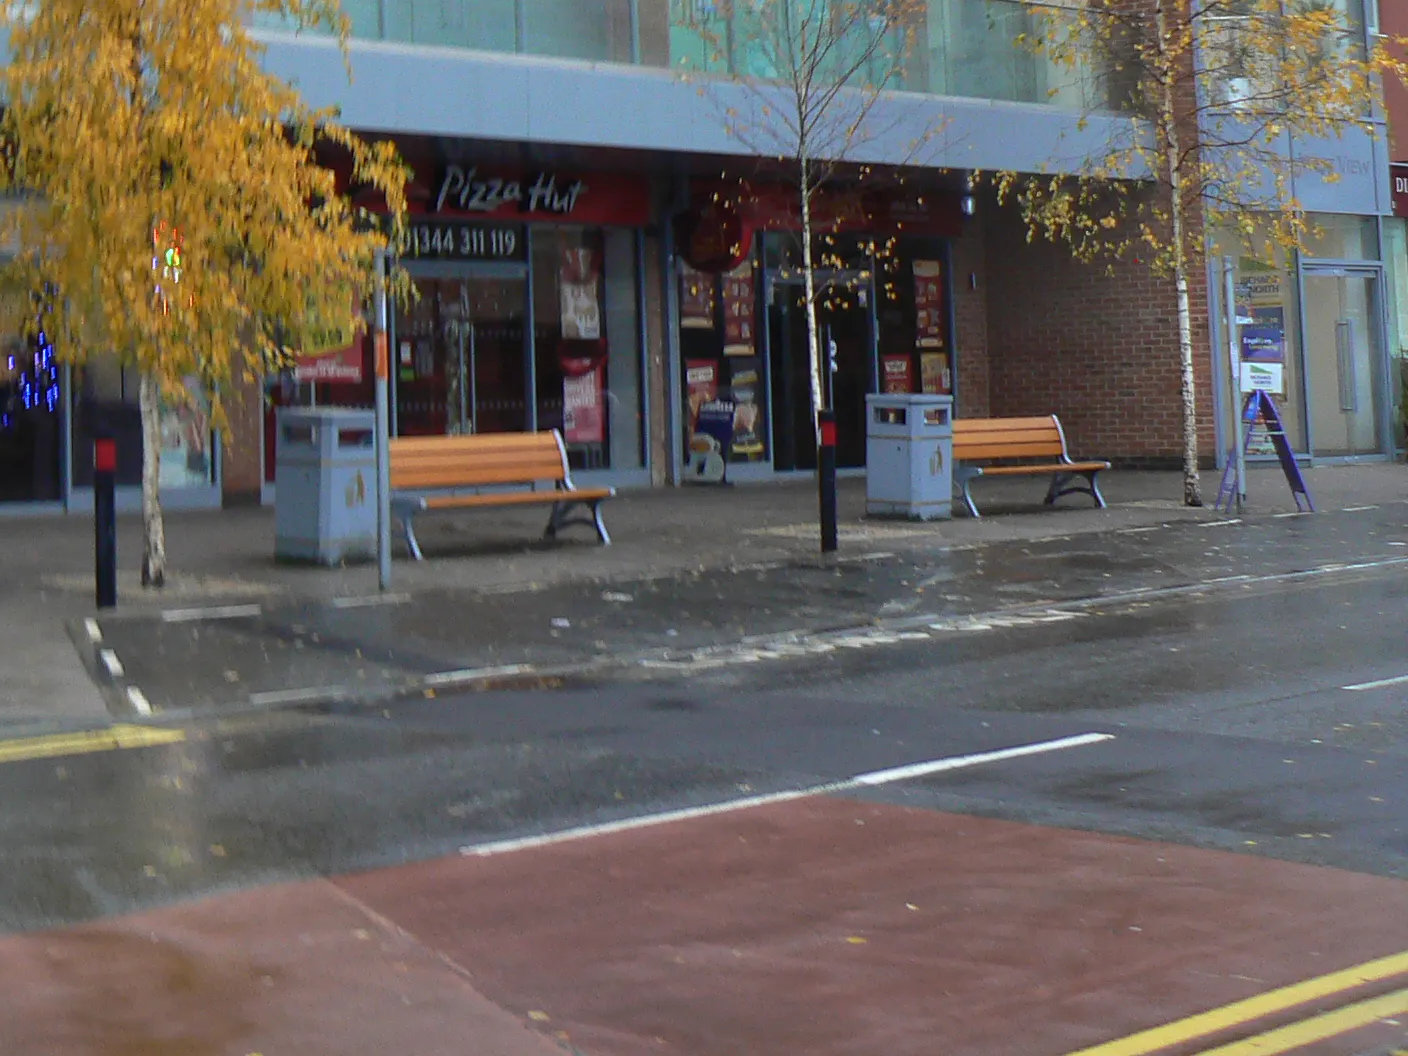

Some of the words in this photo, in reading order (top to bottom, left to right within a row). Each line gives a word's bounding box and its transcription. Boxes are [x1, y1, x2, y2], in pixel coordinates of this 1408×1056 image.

[436, 164, 523, 212] Pizza
[528, 171, 588, 213] Hut
[460, 227, 485, 257] 311
[491, 228, 516, 257] 119
